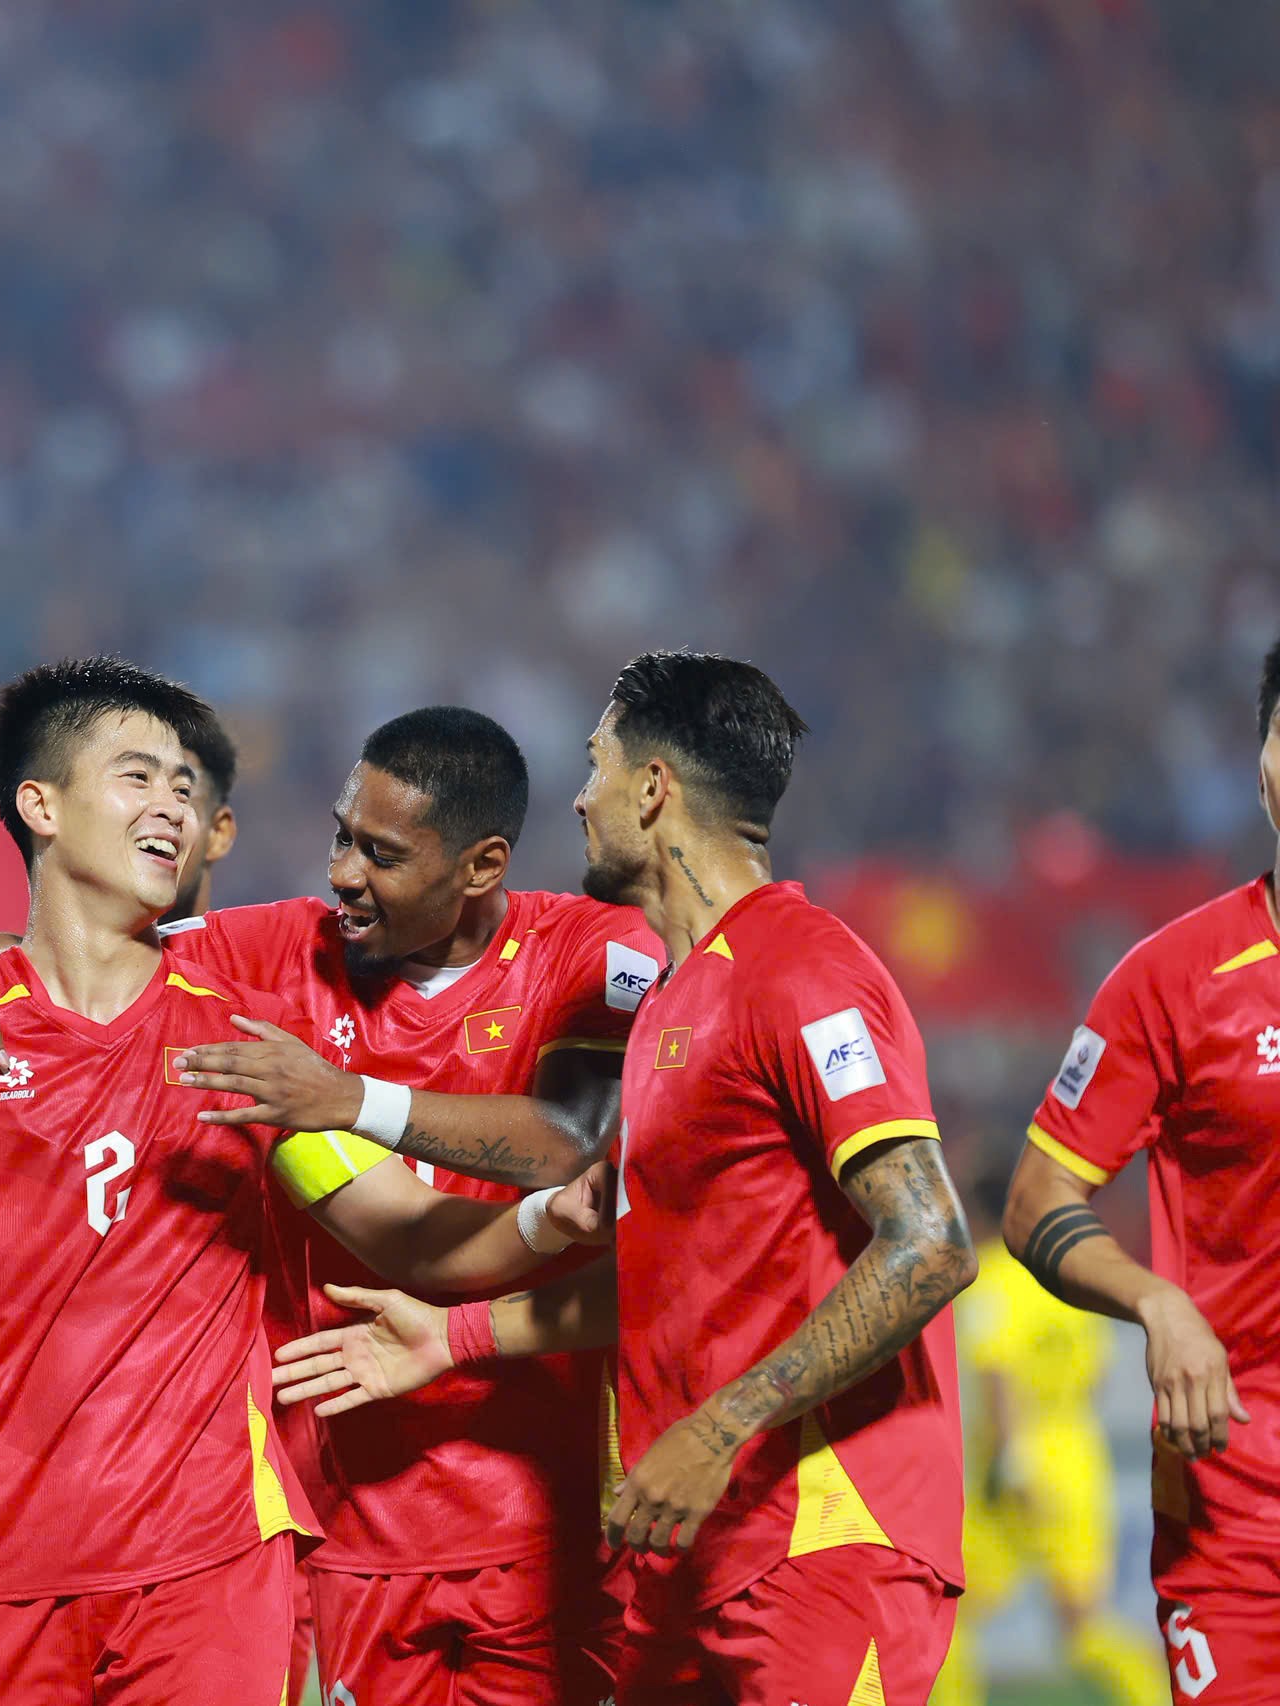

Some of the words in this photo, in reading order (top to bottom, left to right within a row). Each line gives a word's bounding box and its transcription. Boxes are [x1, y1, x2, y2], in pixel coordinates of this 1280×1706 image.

[611, 971, 652, 992] AFC
[825, 1037, 865, 1070] AFC
[84, 1130, 135, 1237] 2
[1168, 1604, 1218, 1700] 5
